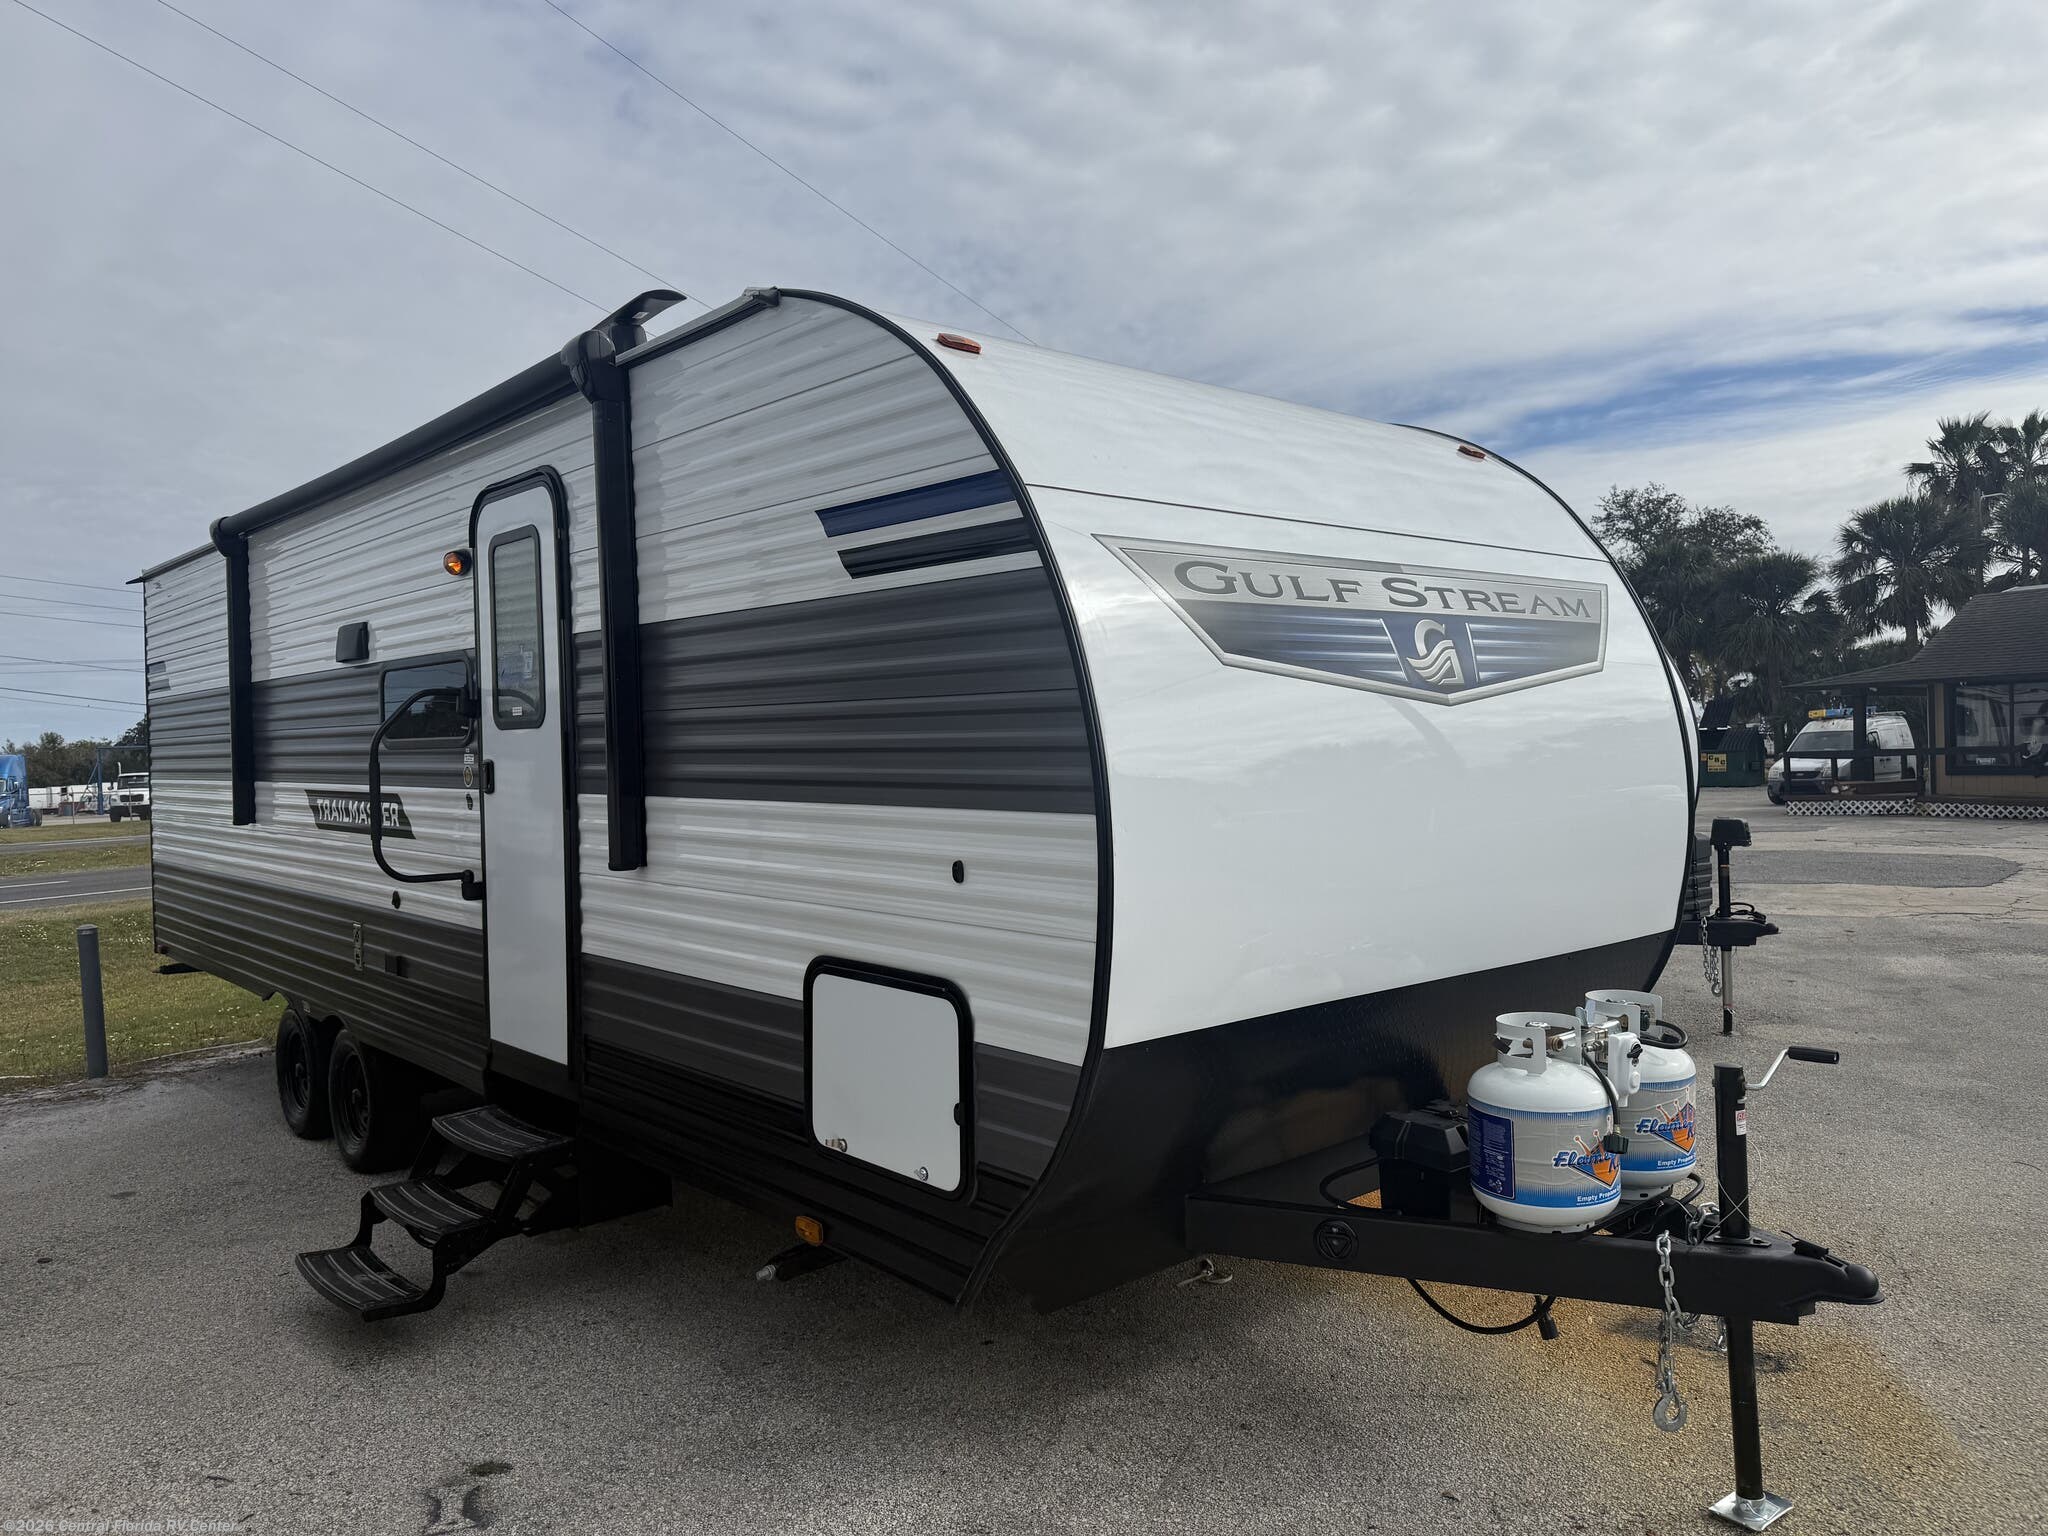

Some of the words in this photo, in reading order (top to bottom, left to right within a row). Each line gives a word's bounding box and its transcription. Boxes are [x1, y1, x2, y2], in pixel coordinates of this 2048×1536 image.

[1175, 560, 1362, 603] GULF
[1381, 577, 1592, 619] STREAM
[316, 798, 400, 827] TRAILMAER
[1576, 1194, 1598, 1203] Empty
